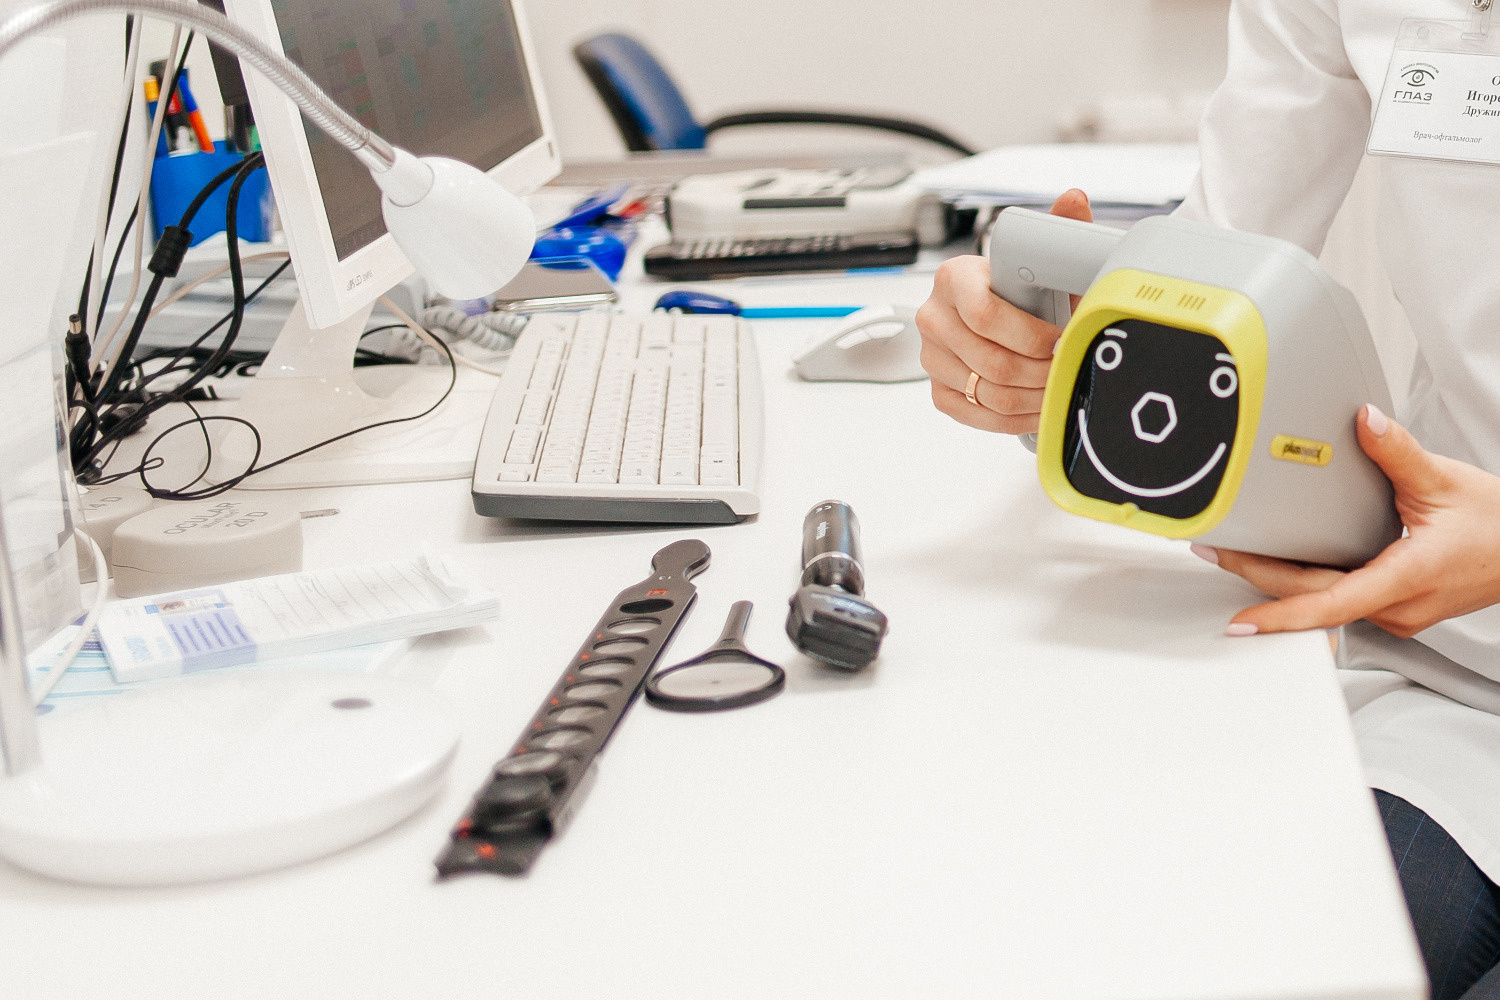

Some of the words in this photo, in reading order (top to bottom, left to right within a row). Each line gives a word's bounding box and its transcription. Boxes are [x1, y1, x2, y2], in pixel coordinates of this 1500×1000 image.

[1393, 90, 1433, 101] ГЛАЗ
[1413, 131, 1482, 143] Врач-офтальмолог
[163, 502, 242, 535] OCULAR
[225, 518, 256, 528] 20
